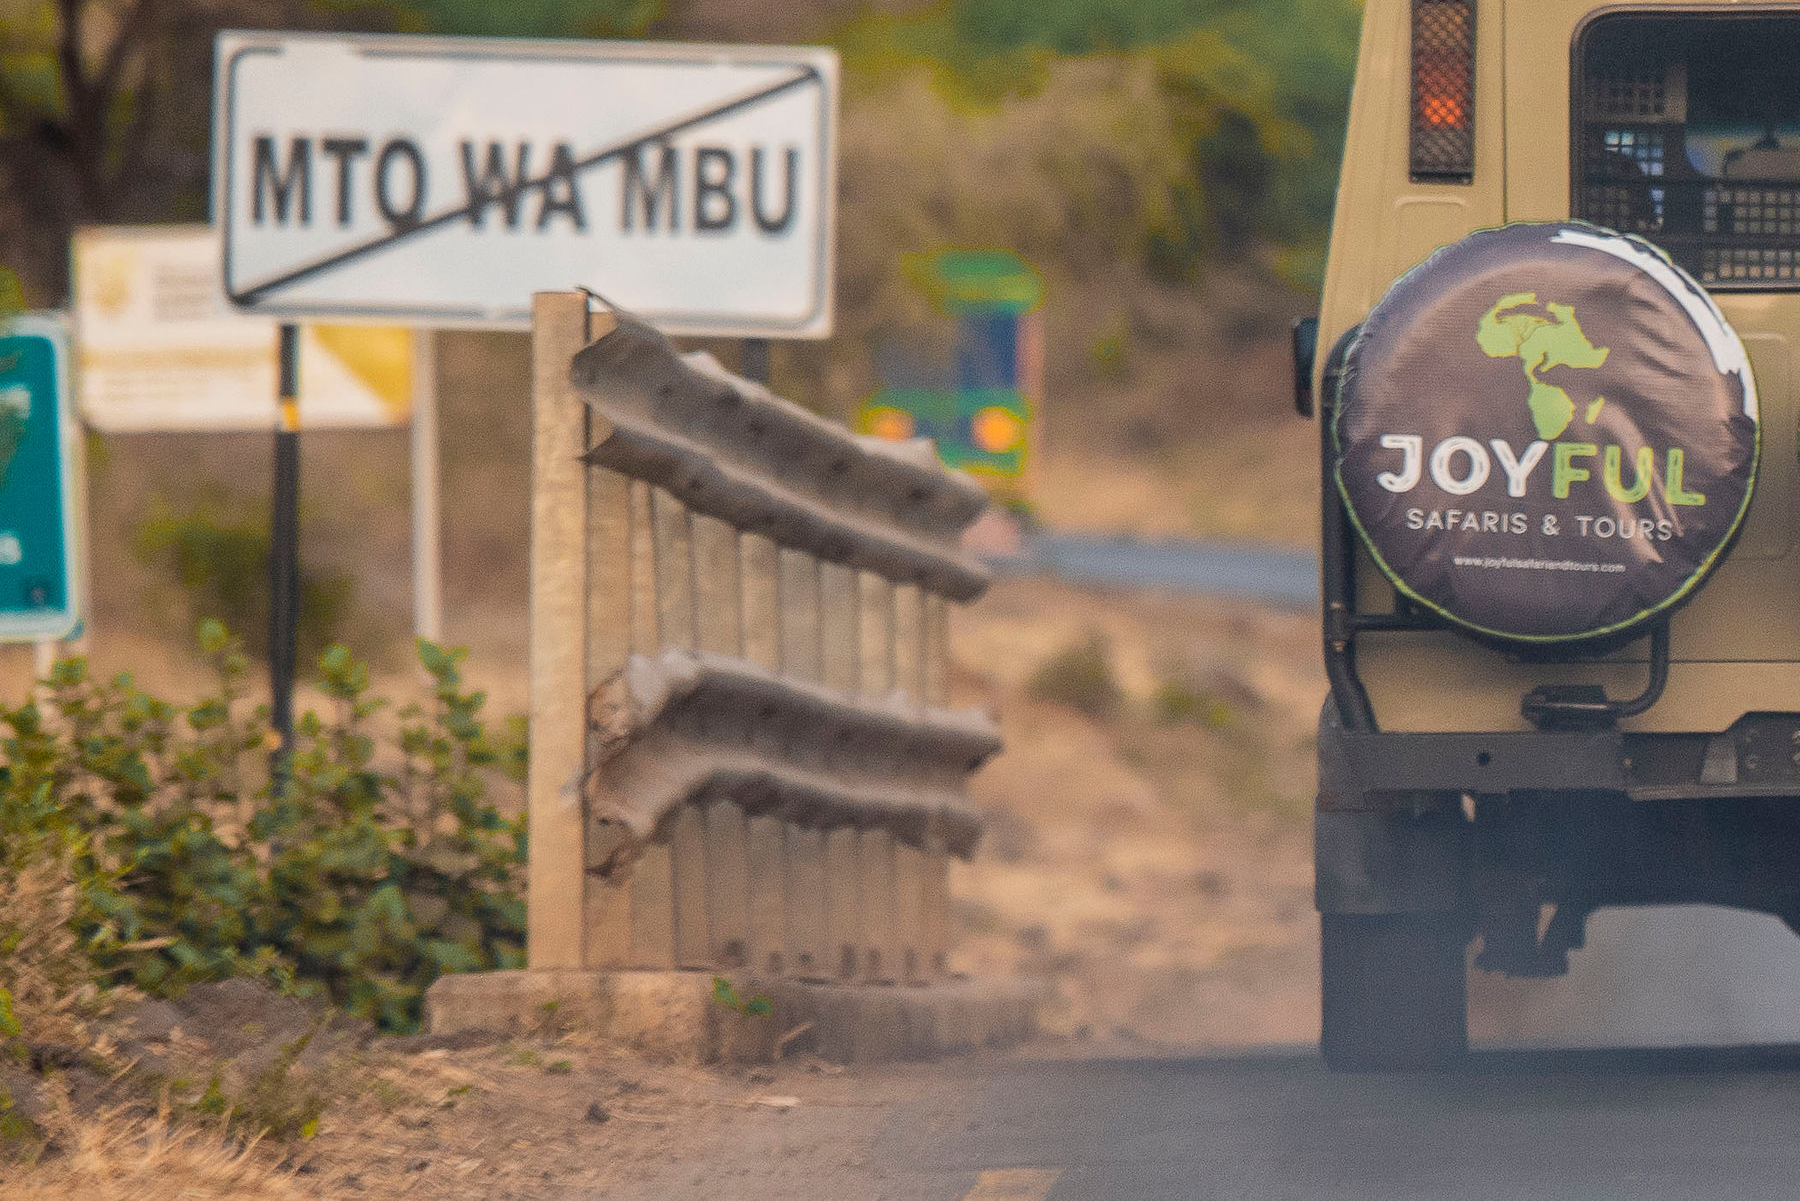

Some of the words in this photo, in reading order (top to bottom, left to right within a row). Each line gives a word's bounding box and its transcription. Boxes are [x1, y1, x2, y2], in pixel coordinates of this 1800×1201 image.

[251, 136, 428, 229] MTO
[460, 140, 586, 234] WA
[622, 144, 800, 238] MBU
[1377, 434, 1706, 506] JOYFUL
[1406, 508, 1528, 535] SAFARIS
[1541, 513, 1560, 536] &
[1574, 515, 1674, 541] TOURS
